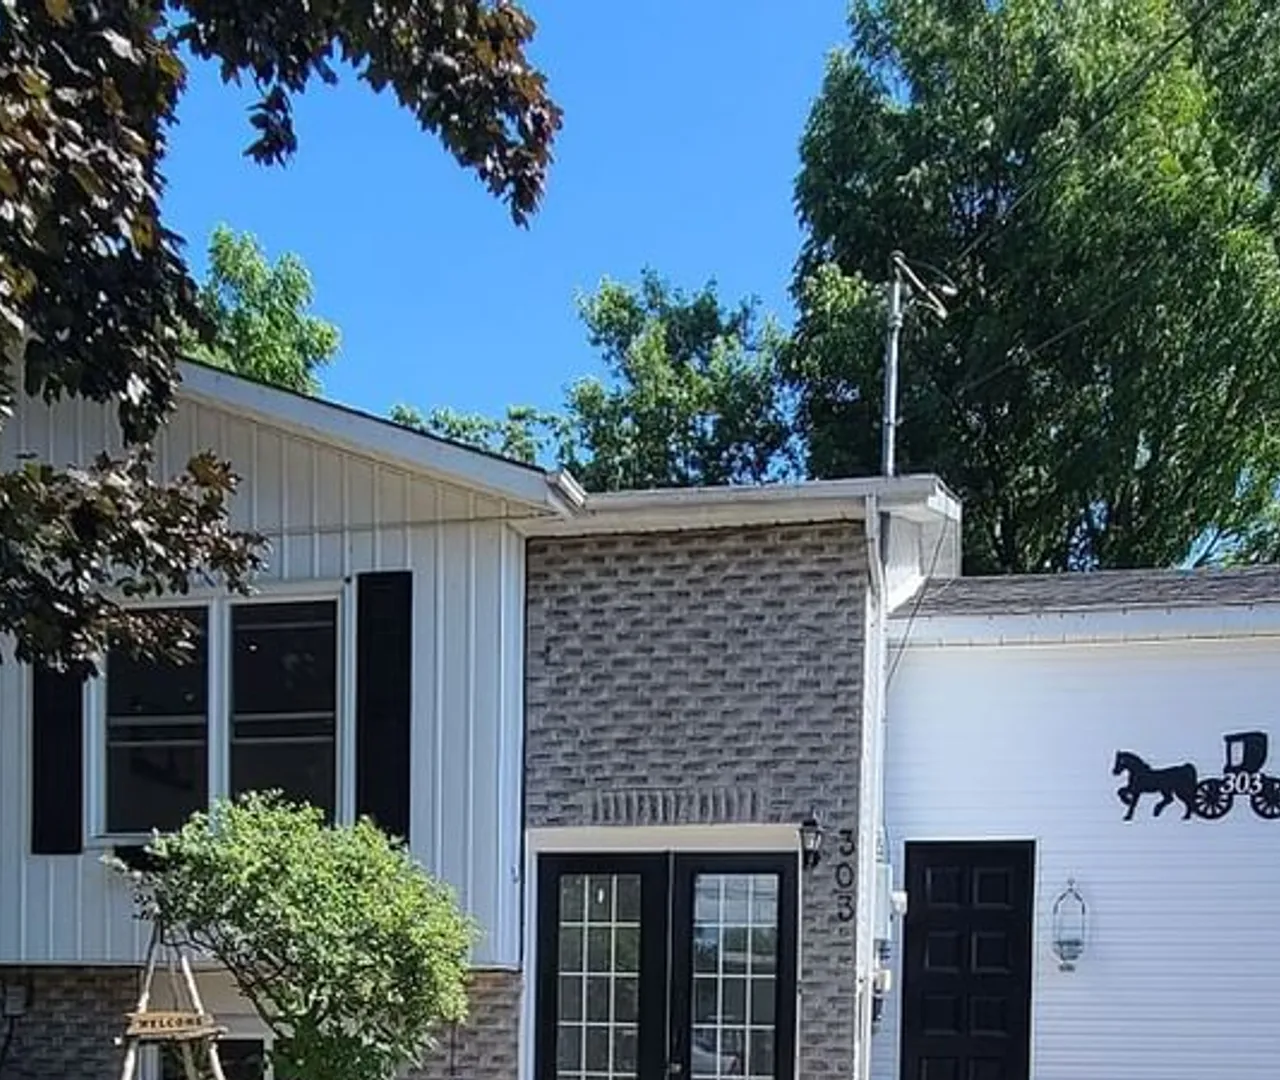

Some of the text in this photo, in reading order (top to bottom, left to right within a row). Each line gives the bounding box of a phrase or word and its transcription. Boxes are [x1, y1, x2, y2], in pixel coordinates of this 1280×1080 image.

[1220, 772, 1263, 794] 303
[835, 829, 855, 922] 303
[138, 1016, 203, 1029] WELCOME
